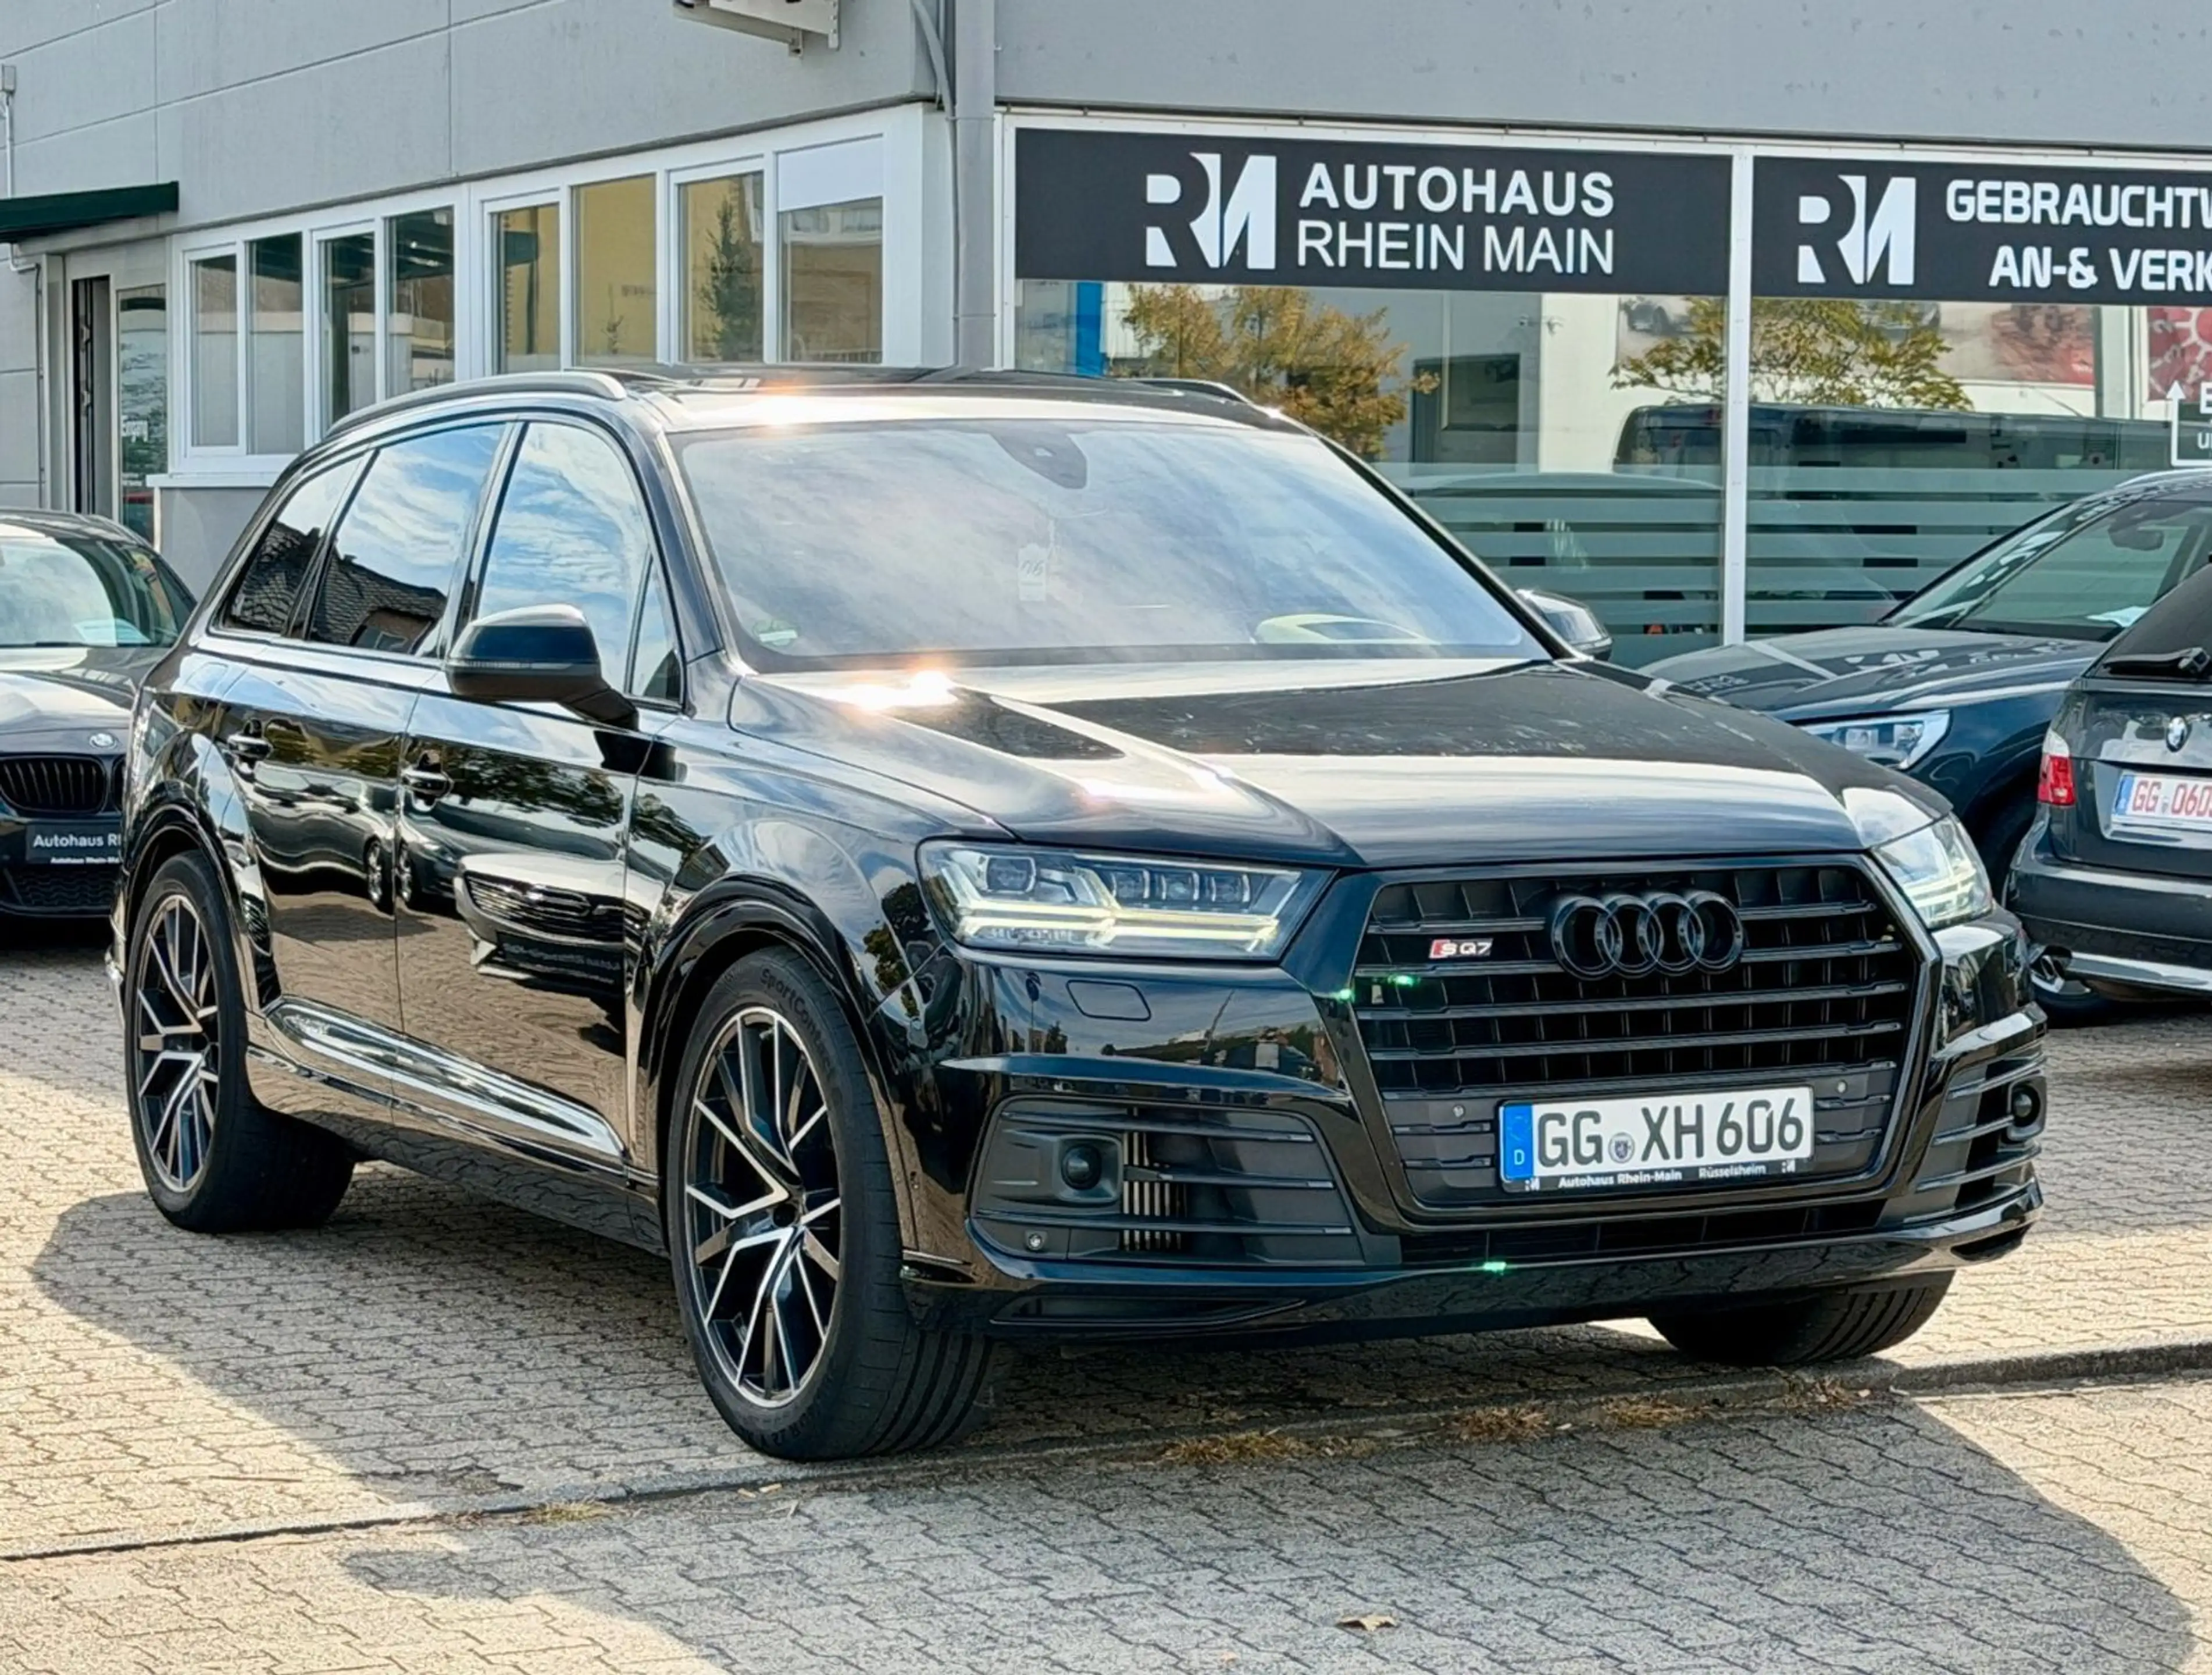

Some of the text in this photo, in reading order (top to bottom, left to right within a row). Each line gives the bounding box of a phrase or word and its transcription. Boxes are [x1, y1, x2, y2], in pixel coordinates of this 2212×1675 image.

[1298, 163, 1614, 218] AUTOHAUS
[1297, 220, 1614, 275] RHEIN MAIN
[1989, 245, 2098, 289] AN-&
[2132, 780, 2162, 812] GG
[33, 833, 104, 847] Autohaus
[1439, 941, 1493, 957] SQ7
[1537, 1097, 1804, 1167] GG XH 606
[1514, 1149, 1525, 1164] D
[1558, 1175, 1614, 1189] Autohaus
[1617, 1170, 1682, 1185] Rhein-Main
[1699, 1164, 1767, 1179] Rüsselsheim
